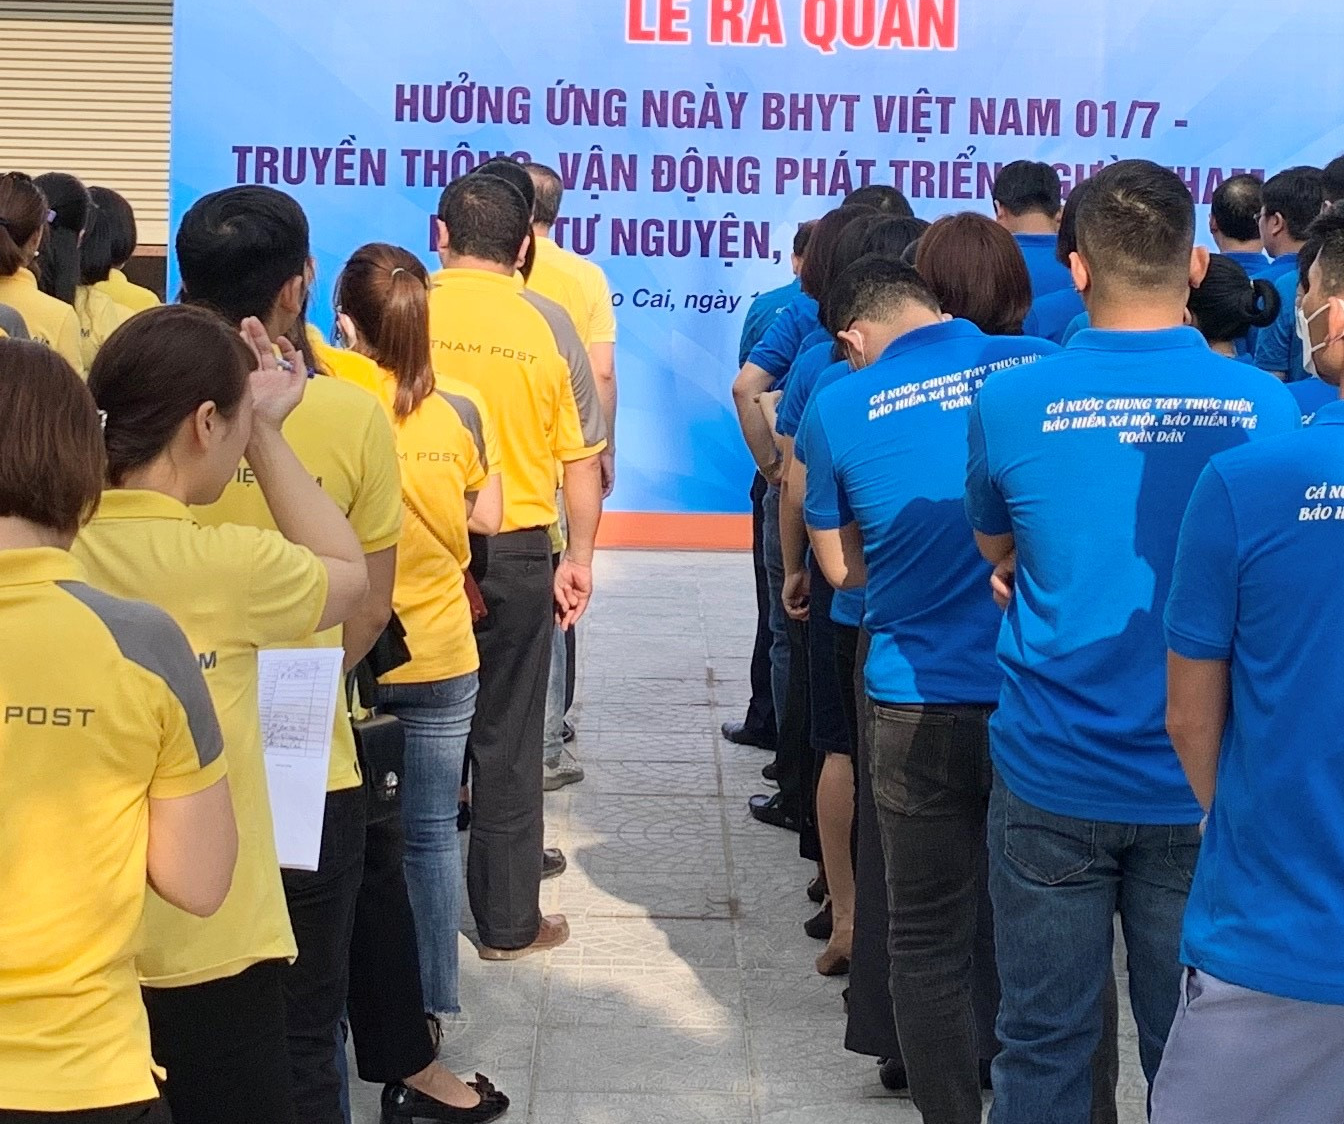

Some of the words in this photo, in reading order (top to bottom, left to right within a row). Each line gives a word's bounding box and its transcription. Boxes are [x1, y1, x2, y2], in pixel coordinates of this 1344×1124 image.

[395, 71, 531, 125] HƯỞNG
[546, 79, 627, 127] ỨNG
[641, 82, 748, 130] NGÀY
[761, 93, 860, 132] BHYT
[873, 88, 955, 143] VIỆT
[969, 97, 1061, 137] NAM
[1075, 99, 1160, 139] 01/7
[232, 134, 386, 188] TRUYỀN
[558, 144, 638, 200] VẬN
[651, 147, 760, 202] ĐỘNG
[775, 150, 876, 196] PHÁT
[611, 212, 781, 267] NGUYỆN,
[633, 288, 675, 311] Cai,
[684, 291, 742, 314] ngày
[491, 346, 537, 365] POST
[5, 706, 95, 726] POST
